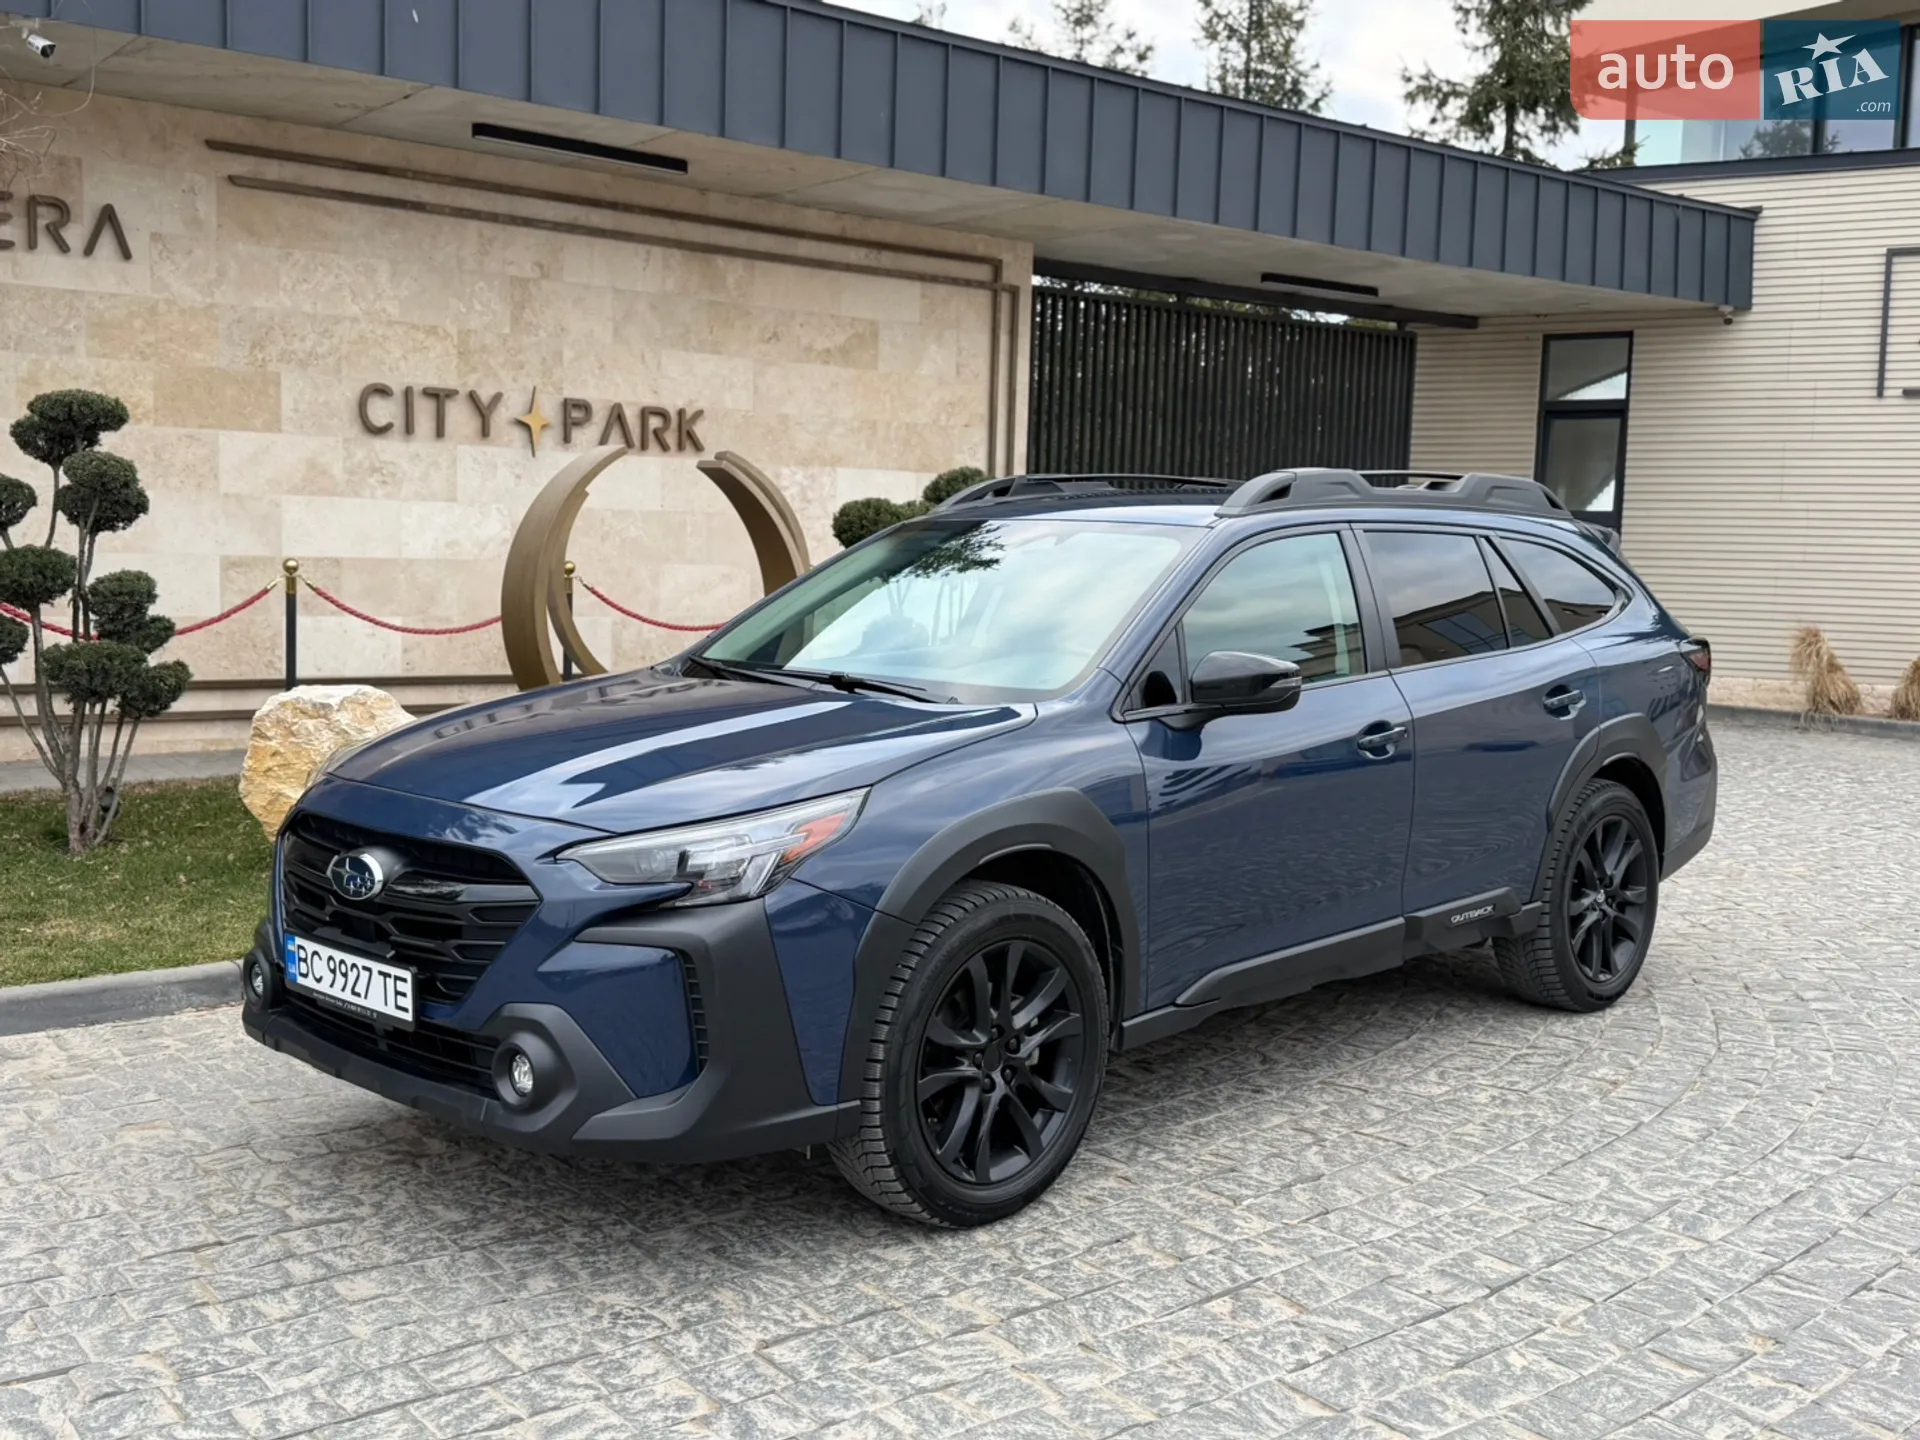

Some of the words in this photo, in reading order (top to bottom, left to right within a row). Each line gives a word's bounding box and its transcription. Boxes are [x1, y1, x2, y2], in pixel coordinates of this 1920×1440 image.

[358, 382, 503, 438] CITY
[563, 398, 705, 452] PARK
[297, 944, 323, 984] BC
[326, 955, 373, 1000] 9927
[377, 970, 409, 1014] TE
